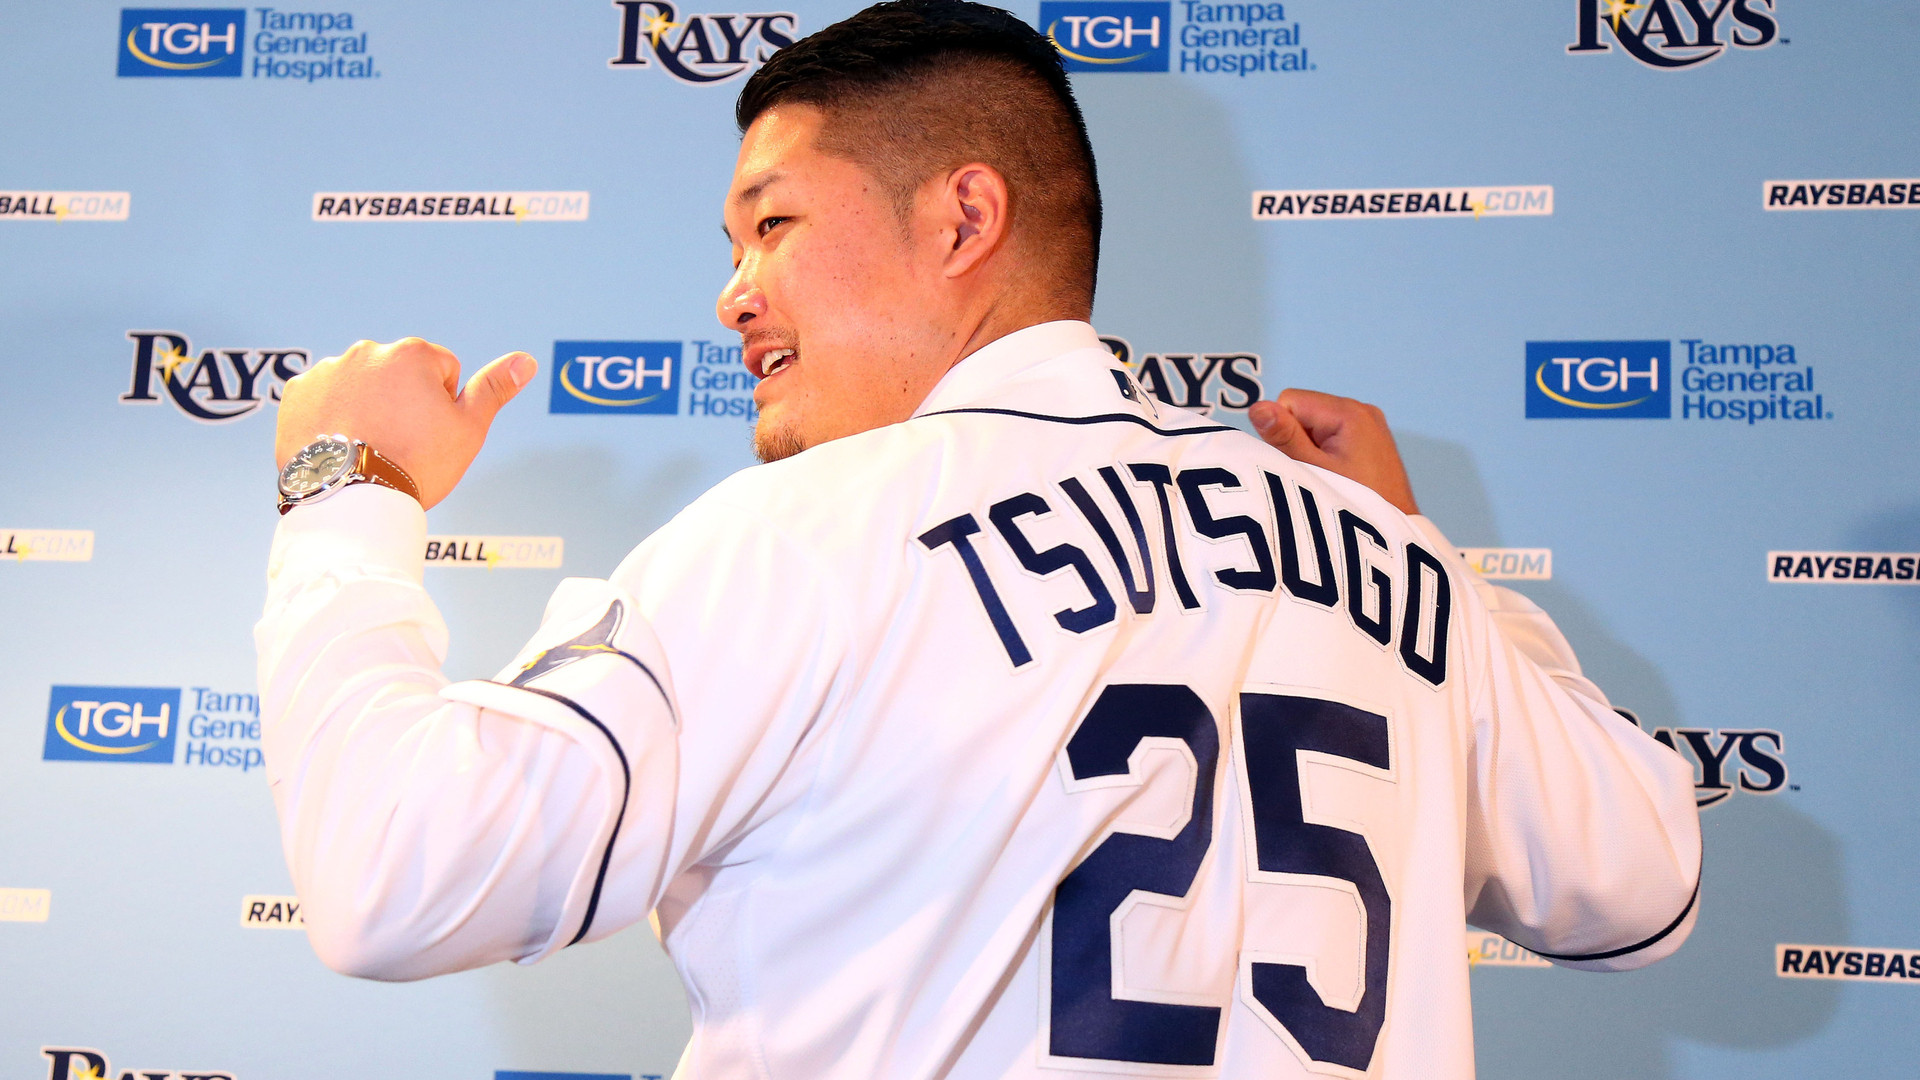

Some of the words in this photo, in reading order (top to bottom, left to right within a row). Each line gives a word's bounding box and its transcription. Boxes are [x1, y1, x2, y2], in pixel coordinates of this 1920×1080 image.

[254, 8, 353, 33] Tampa
[1182, 0, 1285, 26] Tampa
[142, 22, 235, 55] TGH
[254, 32, 368, 55] General
[611, 0, 794, 83] RAYS
[1063, 16, 1160, 49] TGH
[1180, 24, 1300, 49] General
[1568, 0, 1776, 68] RAYS
[251, 55, 381, 82] Hospital.
[1180, 48, 1317, 77] Hospital.
[1681, 339, 1796, 370] Tampa
[123, 334, 307, 420] RAYS
[575, 356, 672, 390] TGH
[1552, 357, 1659, 392] TGH
[1682, 366, 1813, 393] General
[1682, 394, 1834, 425] Hospital.
[916, 462, 1452, 687] TSUTSUGO
[1773, 556, 1920, 580] RAYSBAS
[73, 700, 170, 738] TGH
[1049, 683, 1393, 1072] 25
[248, 902, 303, 922] RAY
